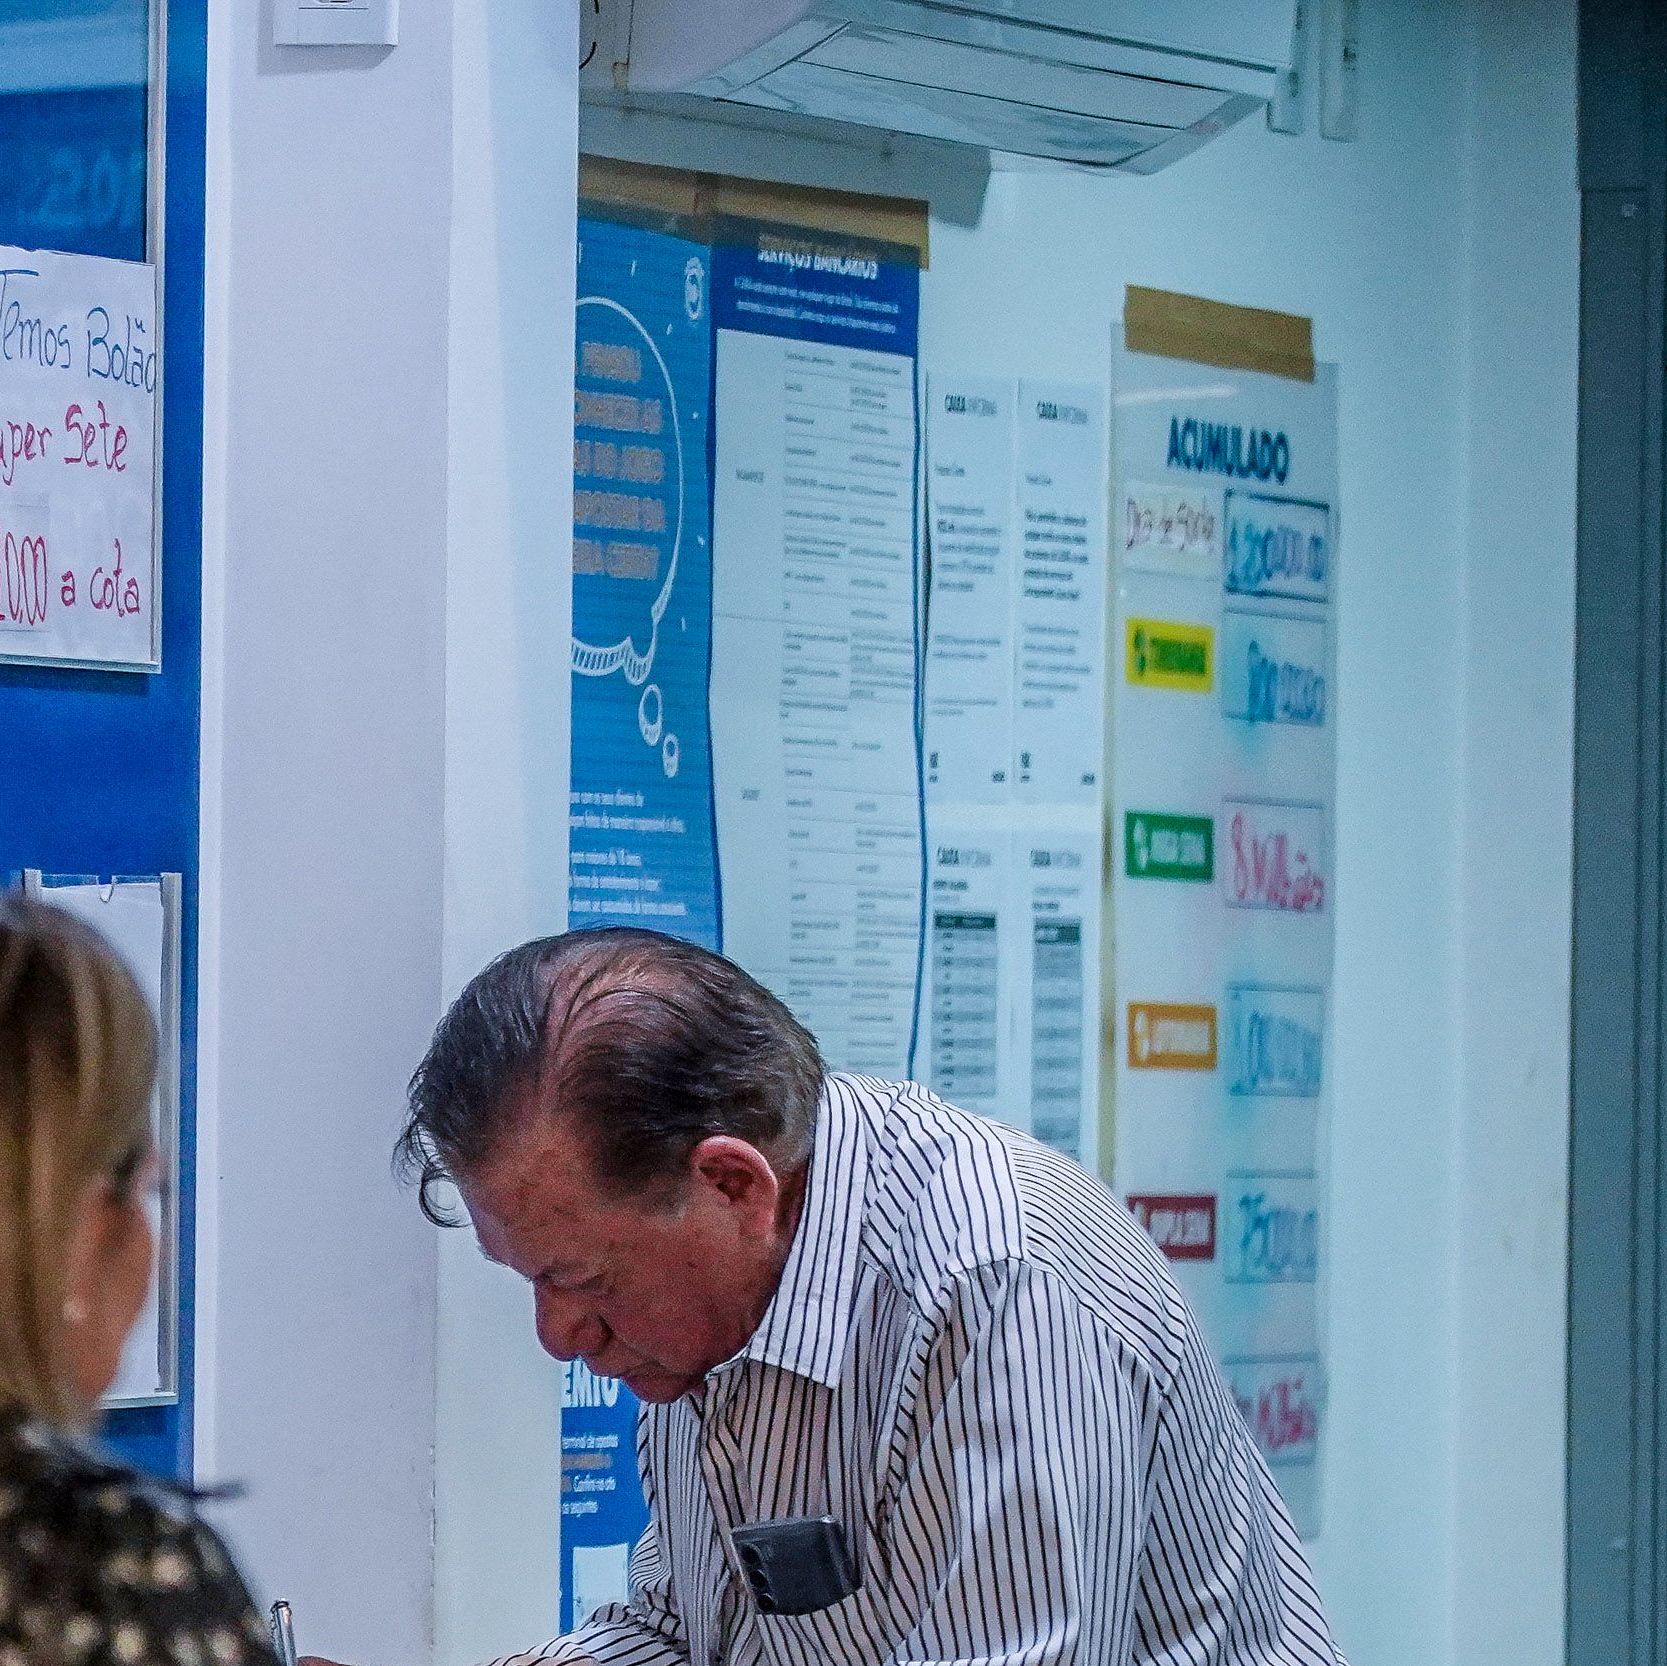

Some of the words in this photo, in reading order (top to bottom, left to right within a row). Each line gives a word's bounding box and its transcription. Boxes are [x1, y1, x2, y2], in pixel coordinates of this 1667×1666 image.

[87, 306, 156, 394] Bolão
[63, 399, 128, 472] Sete
[1167, 415, 1291, 487] ACUMULADO
[61, 571, 76, 607] a
[90, 538, 140, 618] cota
